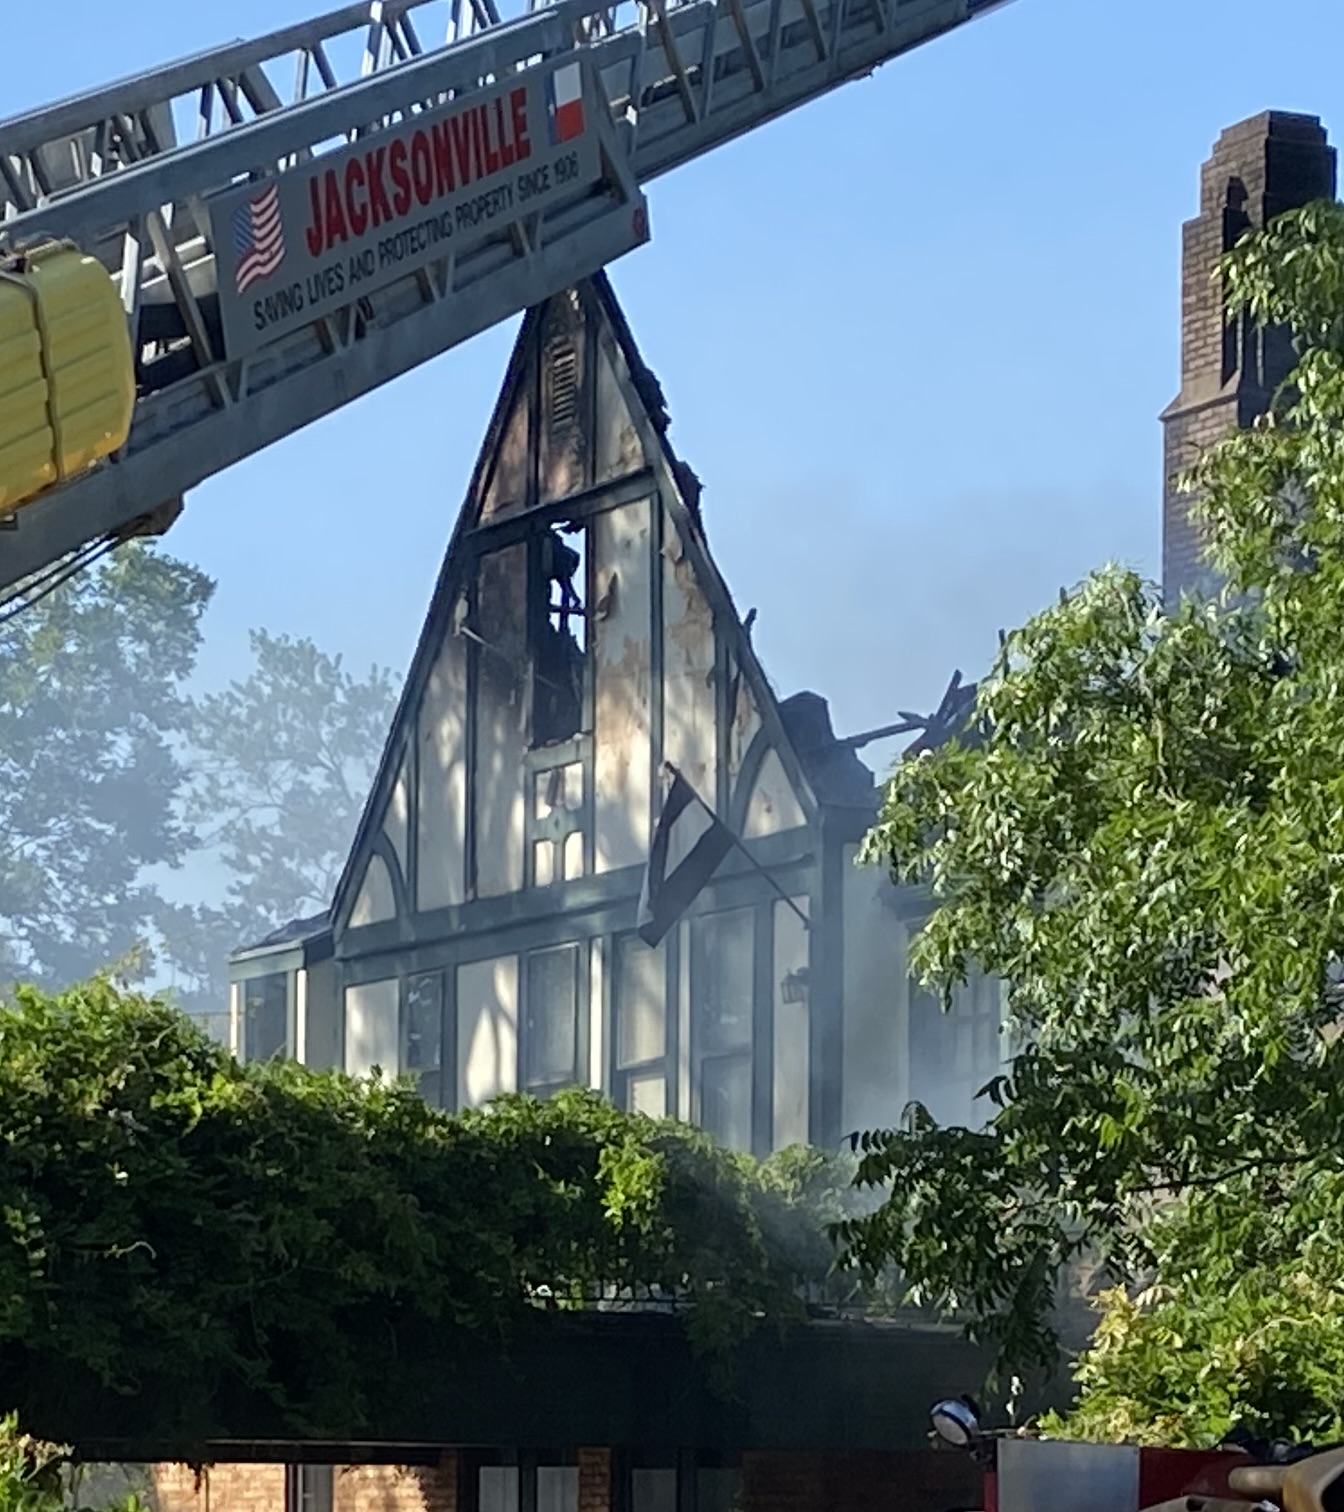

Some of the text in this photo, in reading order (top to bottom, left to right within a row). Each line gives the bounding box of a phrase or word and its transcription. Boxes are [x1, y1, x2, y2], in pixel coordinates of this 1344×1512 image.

[254, 282, 304, 330] SAVING
[307, 261, 345, 305] LIVES
[349, 248, 375, 285] AND
[378, 210, 453, 269] PROTECTING
[455, 181, 513, 233] PROPERTY
[517, 164, 550, 202] SINCE
[306, 86, 532, 258] JACKSONVILLE
